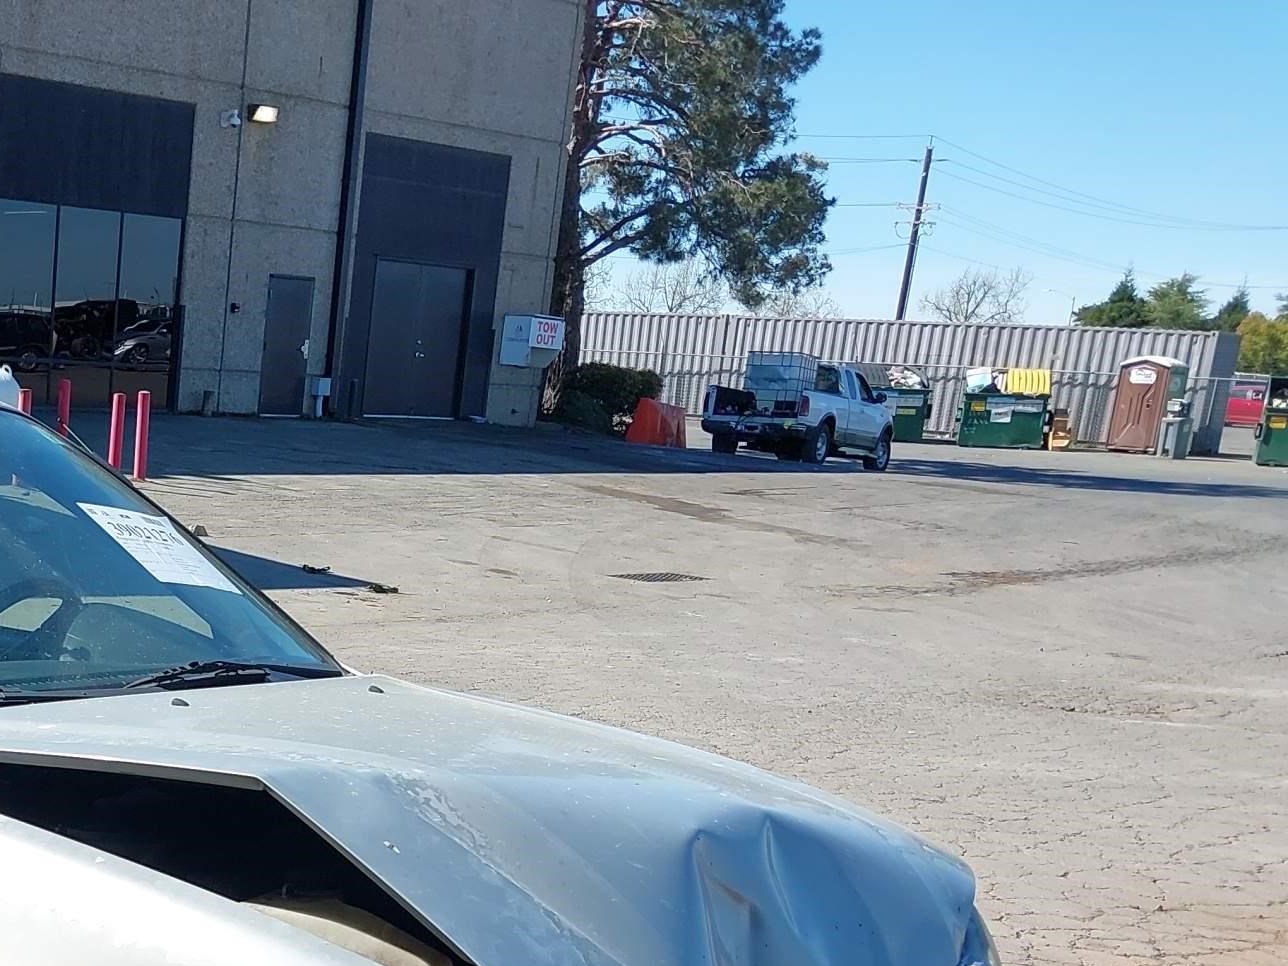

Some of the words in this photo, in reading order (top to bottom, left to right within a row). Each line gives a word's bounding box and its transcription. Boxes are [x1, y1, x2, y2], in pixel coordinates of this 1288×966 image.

[537, 321, 559, 334] TOW
[536, 334, 556, 345] OUT
[107, 521, 184, 546] 39021276
